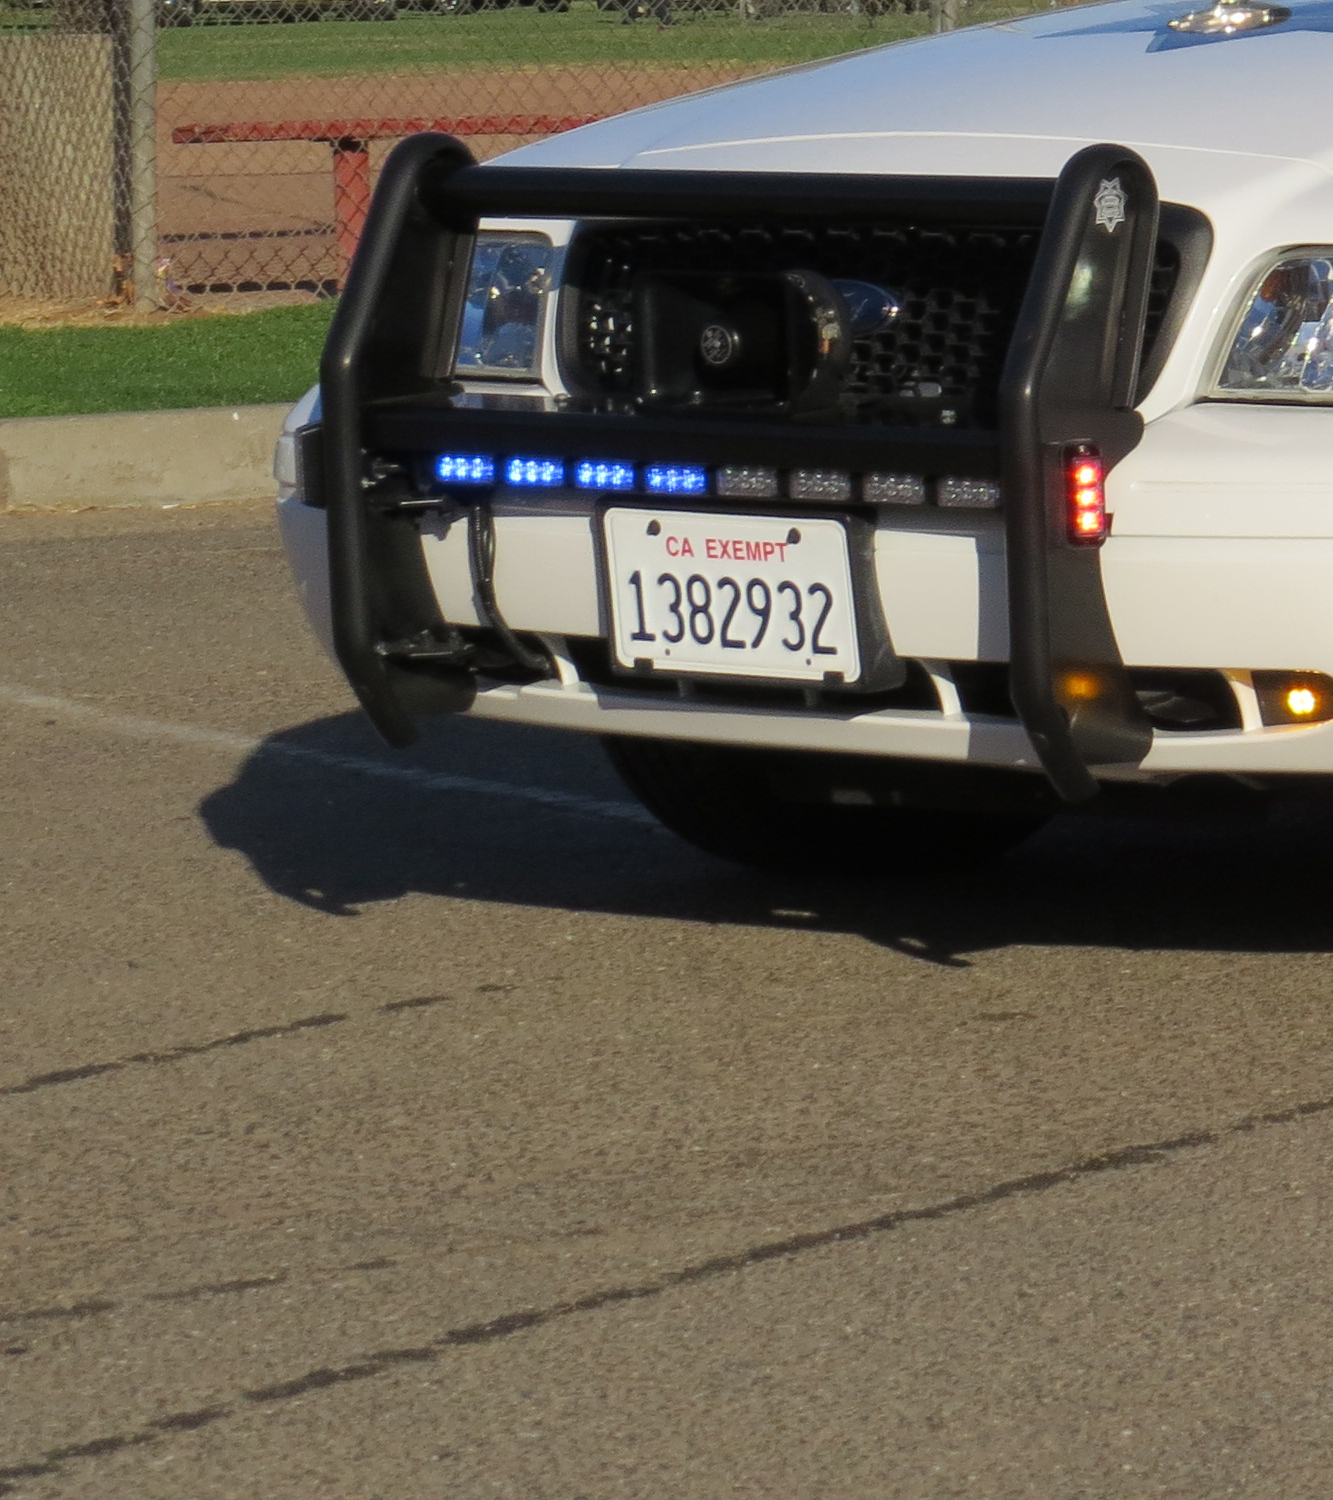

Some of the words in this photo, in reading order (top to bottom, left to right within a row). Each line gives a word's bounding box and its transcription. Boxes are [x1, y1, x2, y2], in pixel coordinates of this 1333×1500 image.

[665, 535, 695, 558] CA
[705, 538, 788, 563] EXEMPT
[629, 569, 839, 656] 1382932
